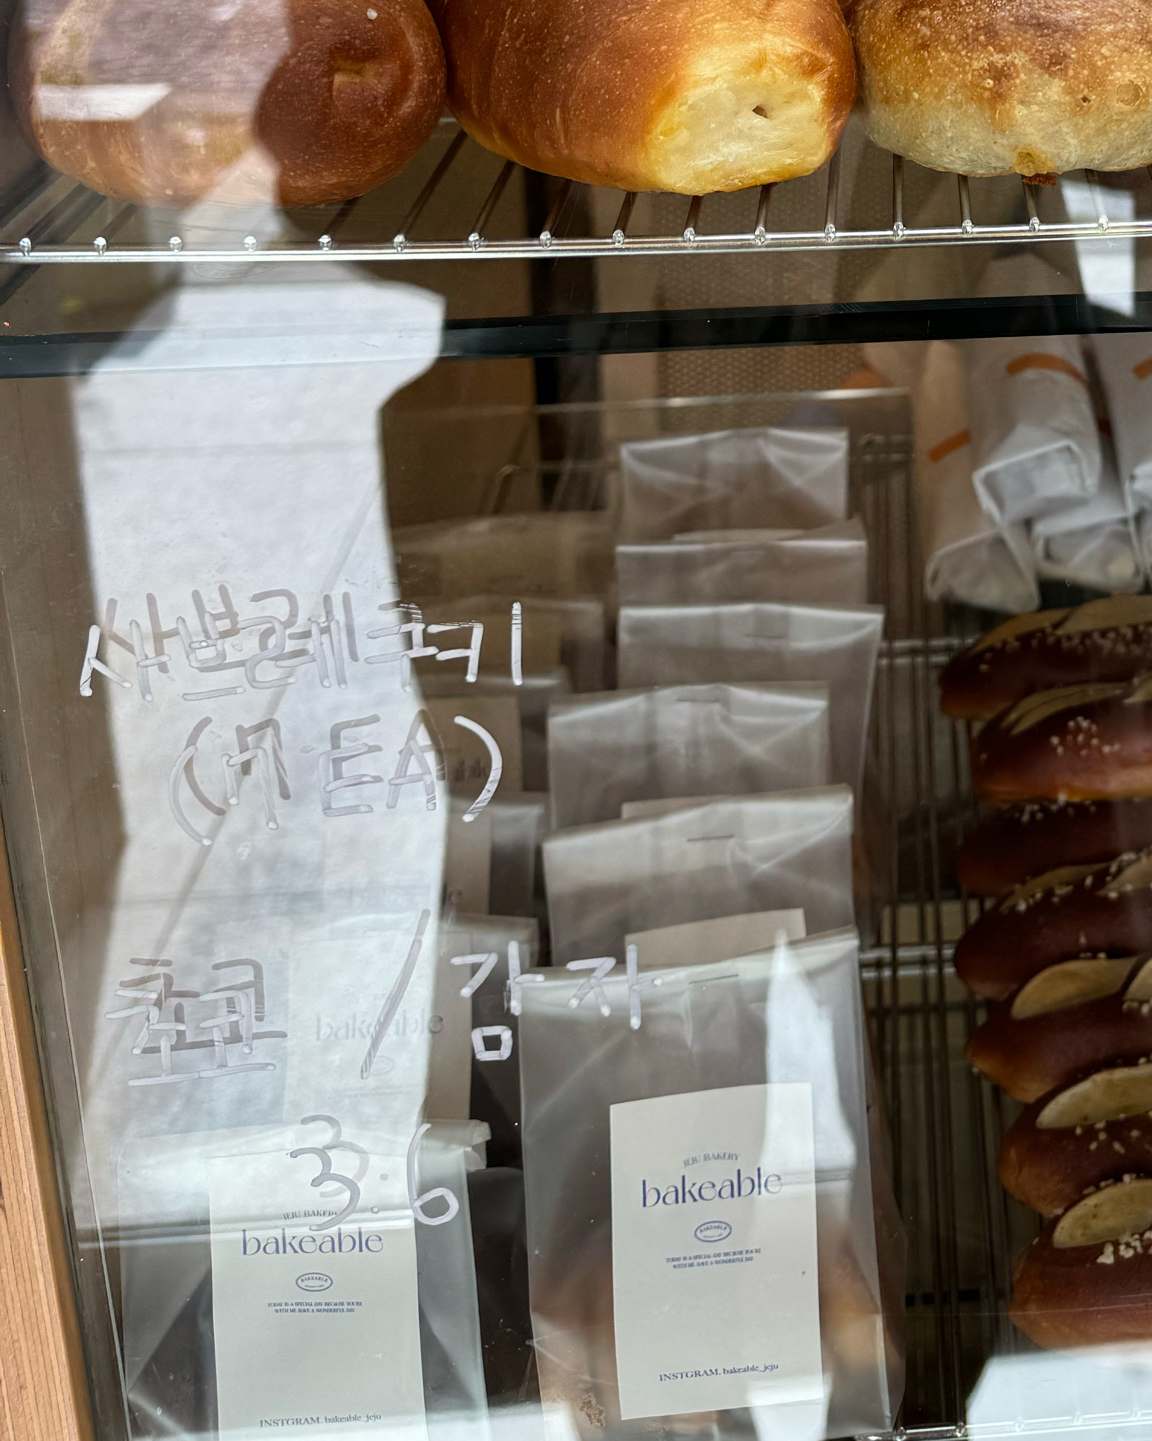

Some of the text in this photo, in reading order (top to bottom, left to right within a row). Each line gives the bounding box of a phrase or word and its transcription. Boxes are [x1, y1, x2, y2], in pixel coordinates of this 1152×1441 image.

[450, 940, 664, 1061] 감자
[288, 1123, 460, 1234] 3.6
[641, 1167, 783, 1208] bakeable
[241, 1227, 384, 1256] bakeable
